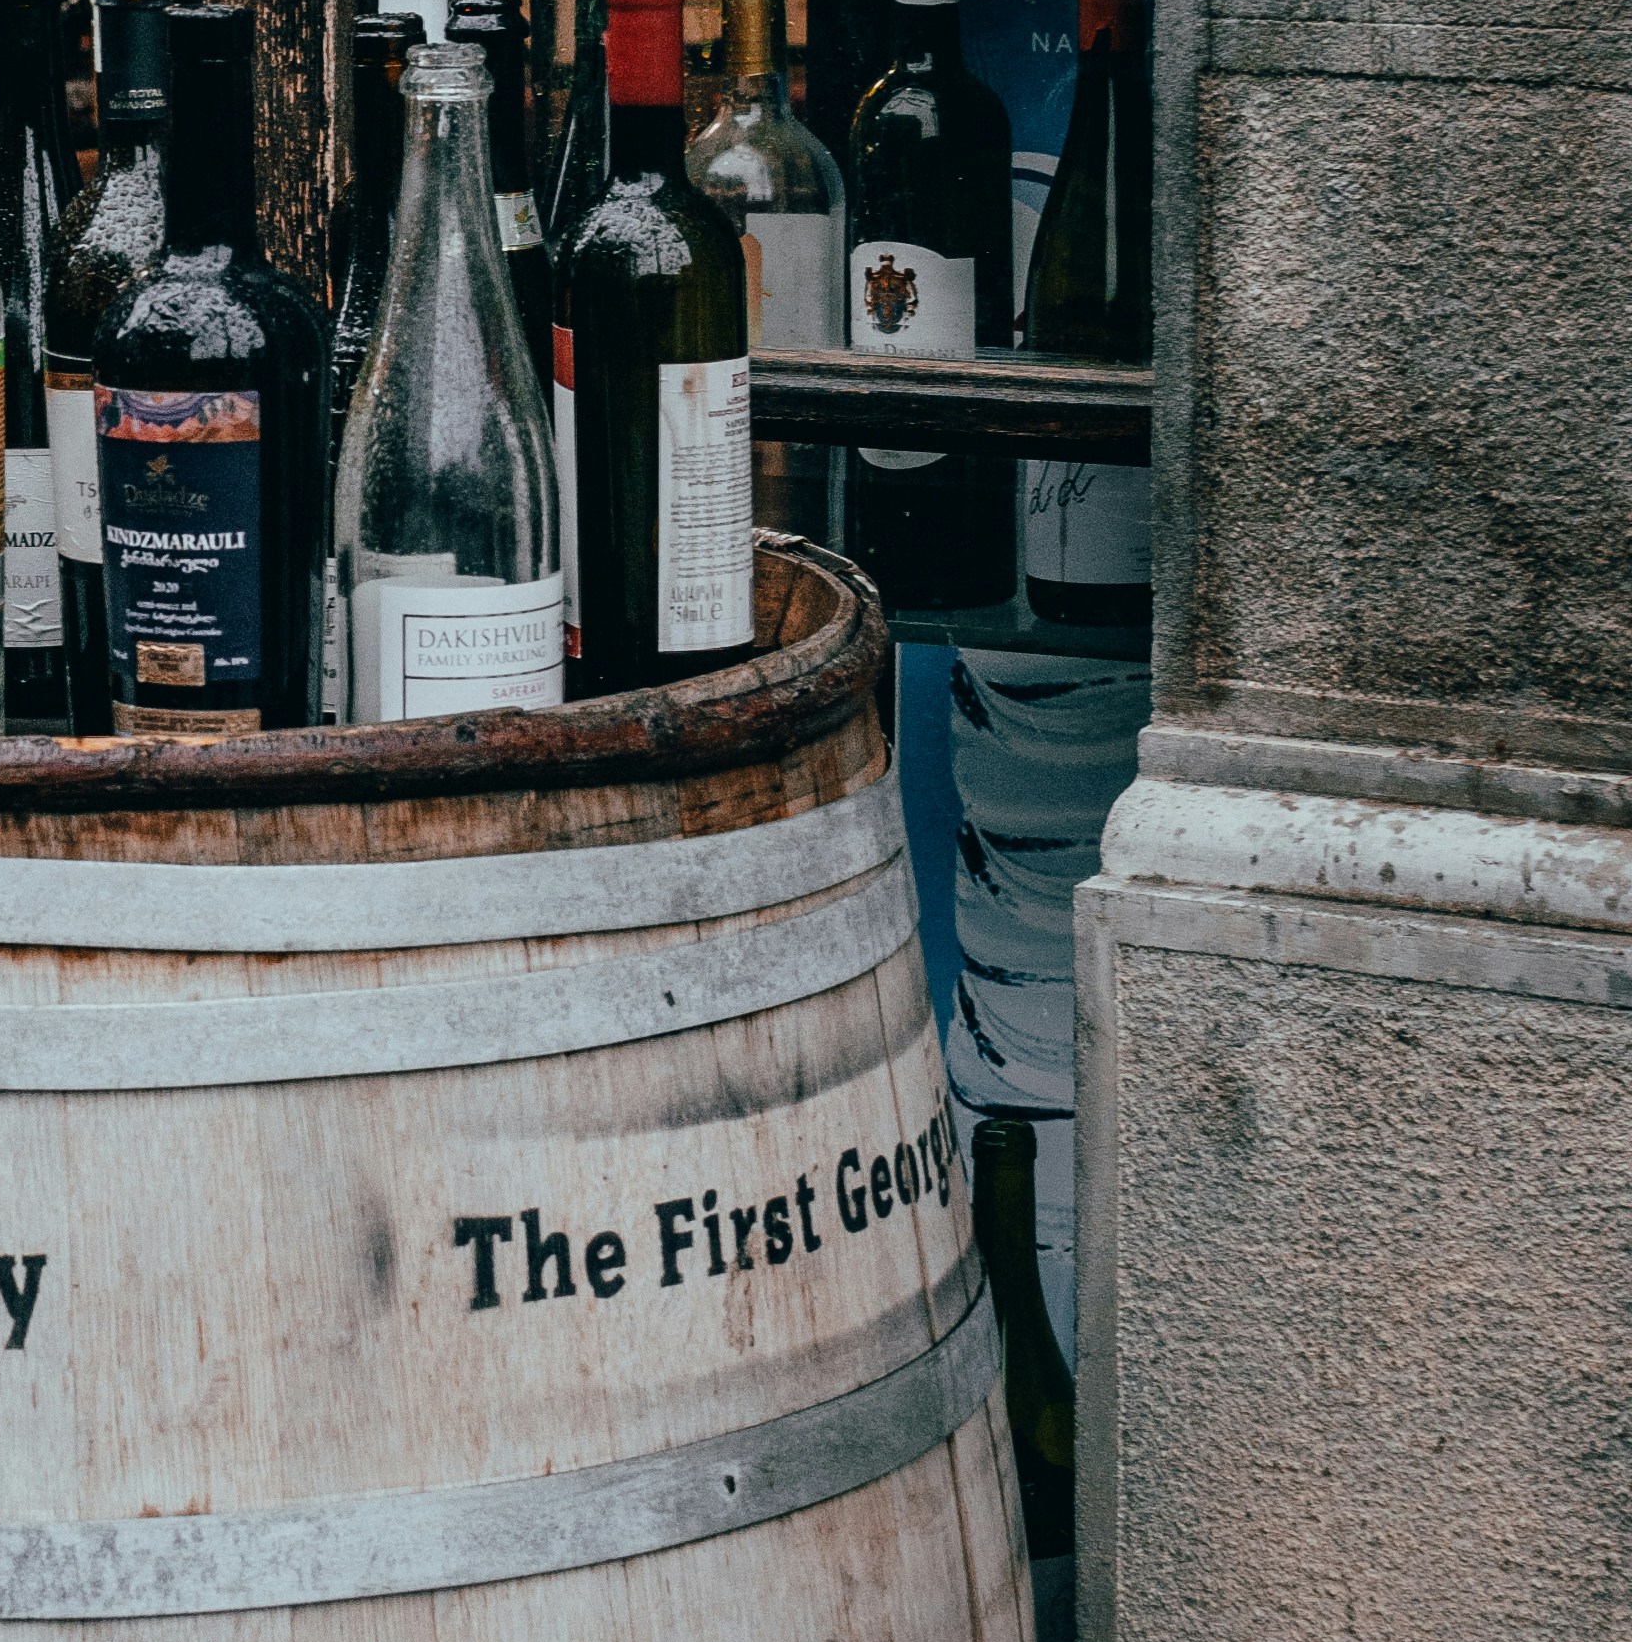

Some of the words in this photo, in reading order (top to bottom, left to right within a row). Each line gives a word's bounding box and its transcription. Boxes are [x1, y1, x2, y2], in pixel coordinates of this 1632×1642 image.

[418, 620, 547, 649] DAKISHVILI
[418, 651, 471, 667] FAMILY
[476, 646, 547, 666] SPARKLING
[453, 1207, 626, 1311] The
[654, 1188, 822, 1288] First
